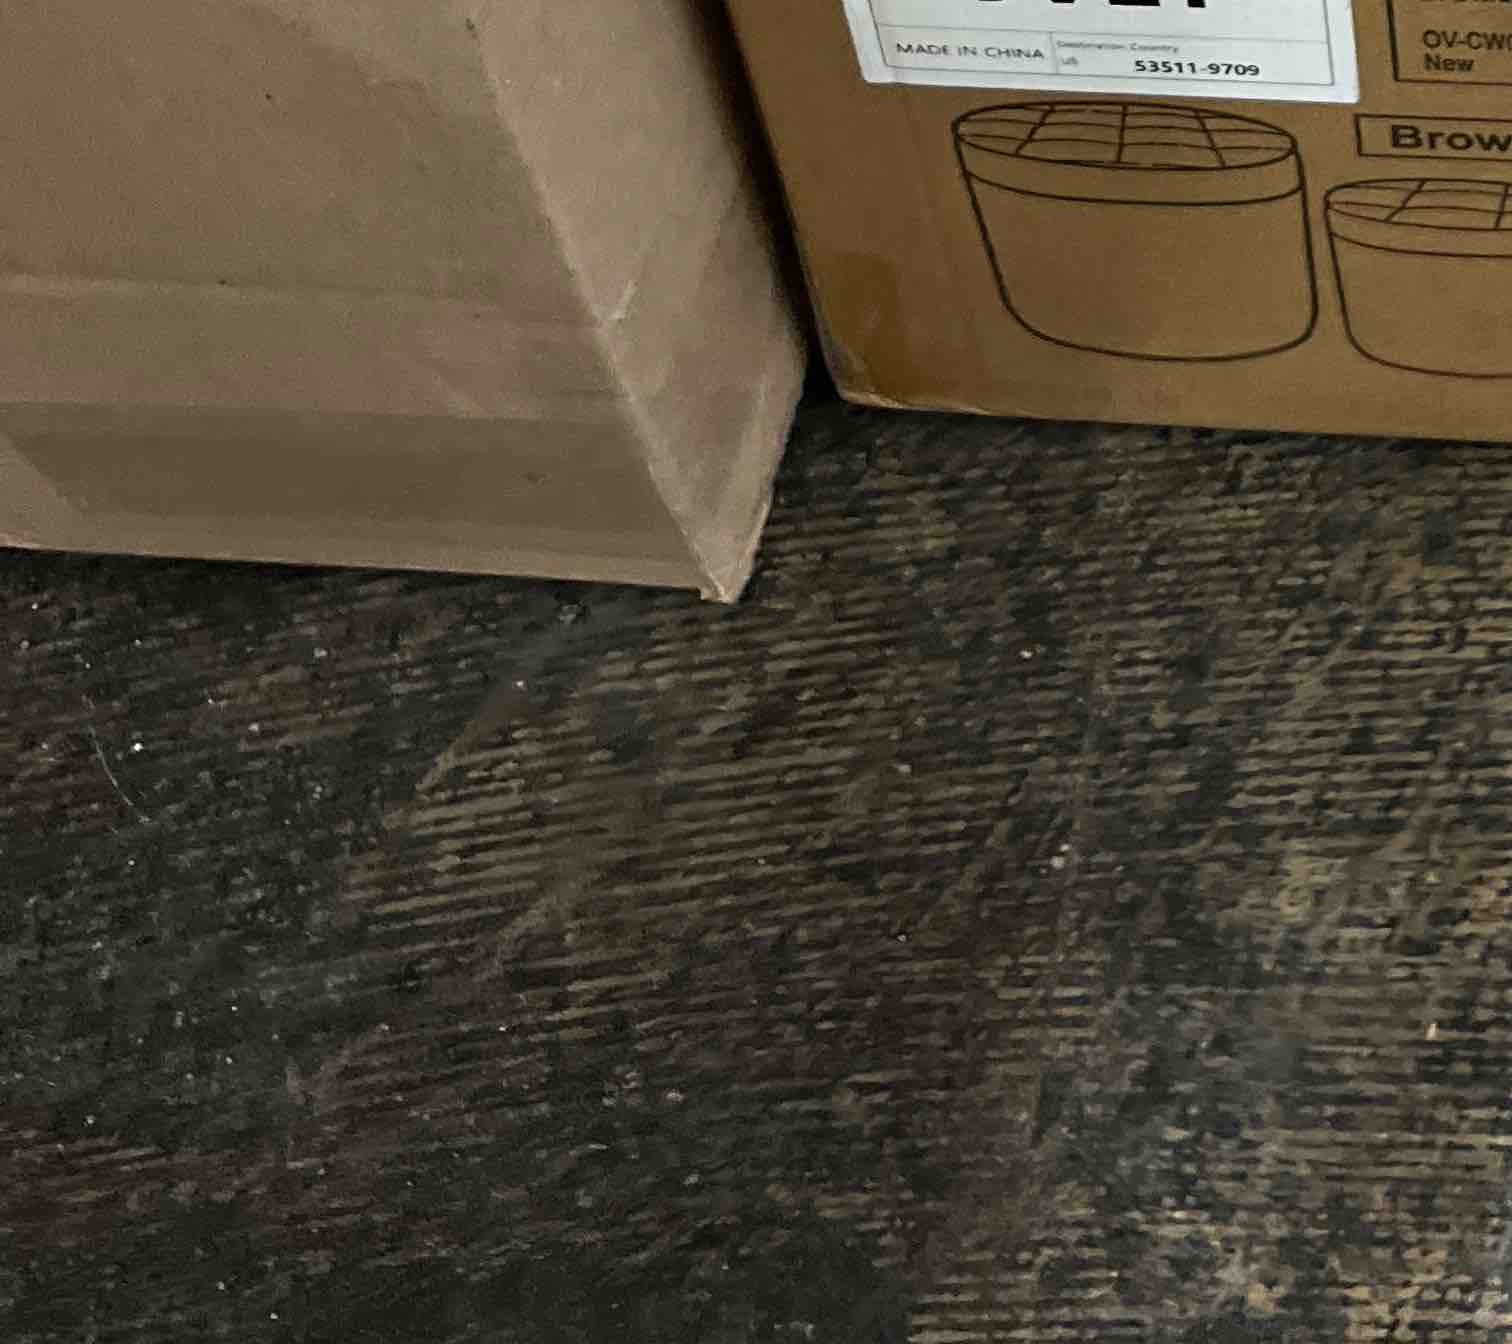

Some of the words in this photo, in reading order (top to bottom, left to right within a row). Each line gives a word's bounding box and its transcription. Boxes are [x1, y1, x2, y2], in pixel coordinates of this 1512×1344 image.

[895, 42, 949, 57] MADE
[957, 44, 978, 57] IN
[984, 46, 1046, 60] CHINA
[1135, 59, 1262, 77] 53511-9709
[1424, 52, 1476, 72] New
